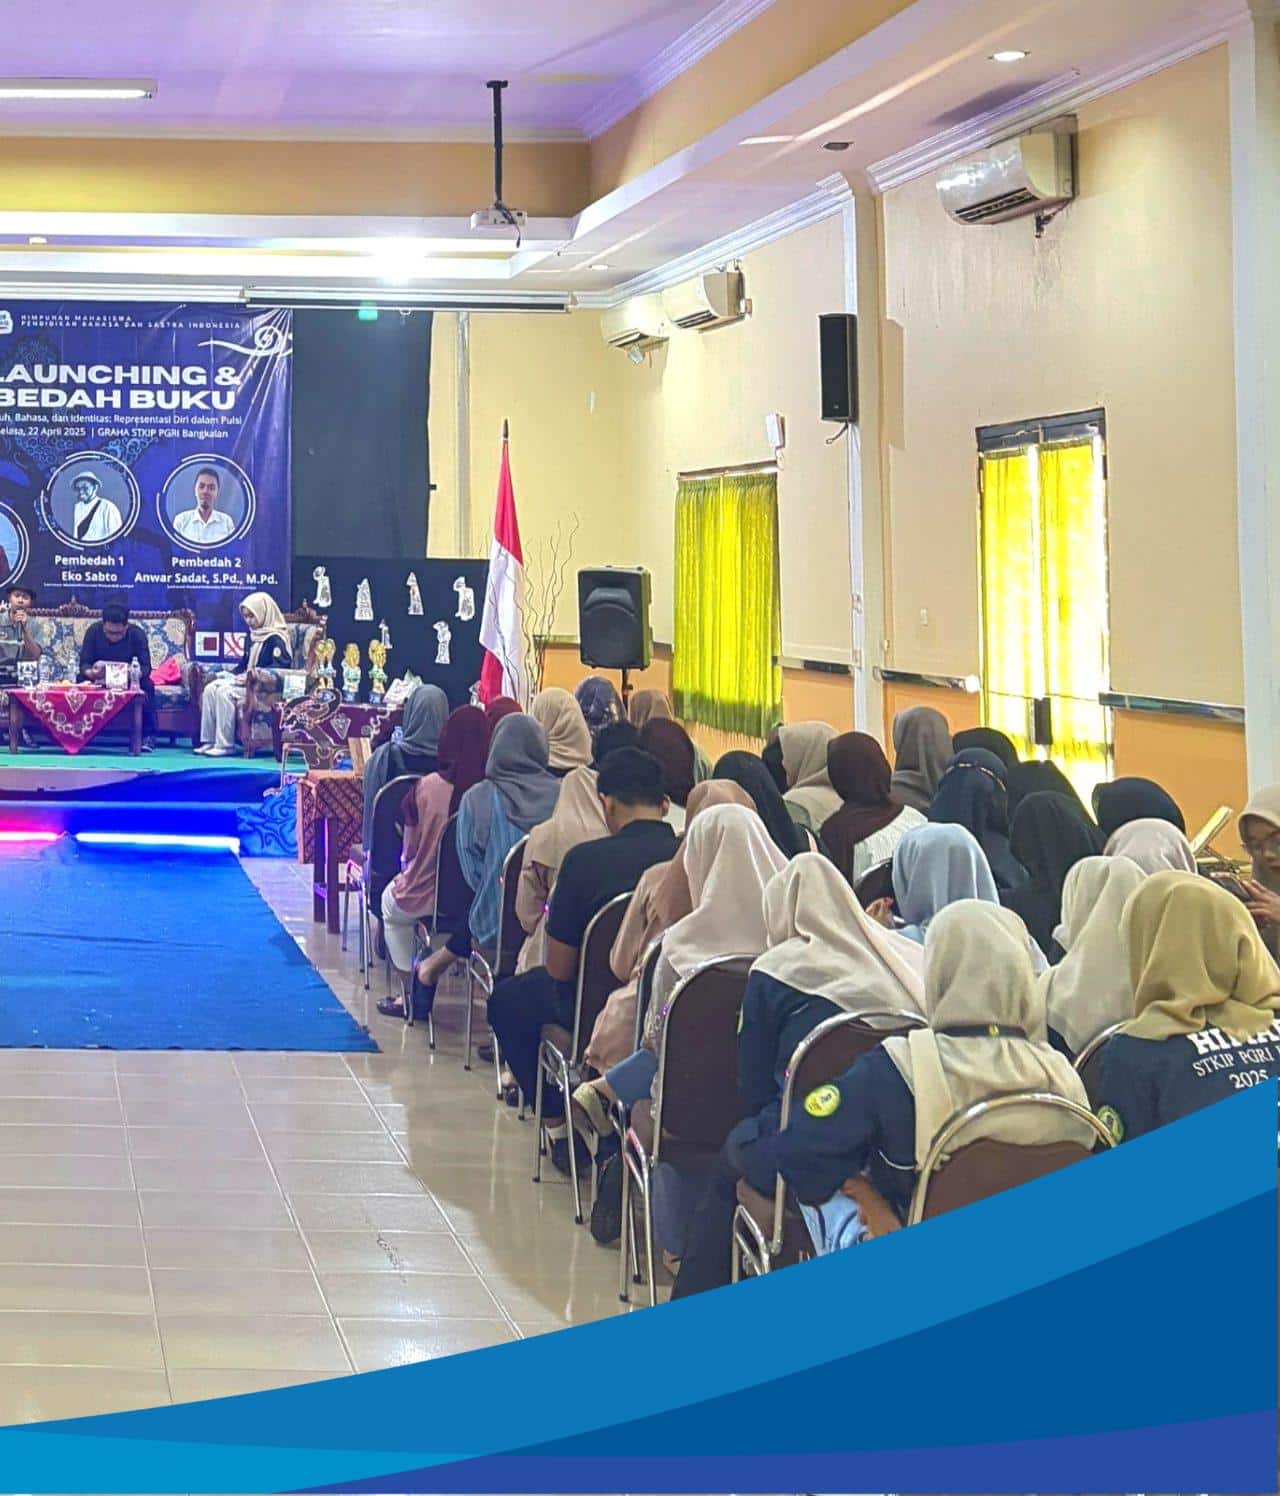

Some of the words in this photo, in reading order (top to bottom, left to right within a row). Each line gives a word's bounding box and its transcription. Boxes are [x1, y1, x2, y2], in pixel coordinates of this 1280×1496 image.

[124, 321, 143, 329] DAN
[214, 366, 237, 386] &
[129, 389, 236, 410] BUKU
[15, 413, 50, 423] Bahasa,
[52, 414, 69, 423] dan
[113, 414, 171, 427] Representasi
[173, 415, 189, 425] Diri
[191, 415, 219, 425] dalam
[221, 415, 242, 425] Puisi
[28, 426, 39, 436] 22
[41, 427, 62, 438] April
[64, 427, 86, 437] 2025
[97, 427, 129, 437] GRAHA
[131, 428, 157, 438] STKIP
[158, 429, 180, 438] PGRI
[182, 429, 229, 441] Bangkalan
[55, 555, 116, 566] Pembedah
[118, 556, 124, 567] 1
[171, 556, 232, 568] Pembedah
[234, 557, 242, 568] 2
[61, 570, 83, 582] Eko
[84, 570, 118, 582] Sabto
[134, 571, 173, 583] Anwar
[174, 572, 210, 584] Sadat,
[212, 573, 243, 585] S.Pd.,
[245, 573, 279, 585] M.Pd.
[1192, 1053, 1235, 1077] STKIP
[1238, 1047, 1275, 1065] PGRI
